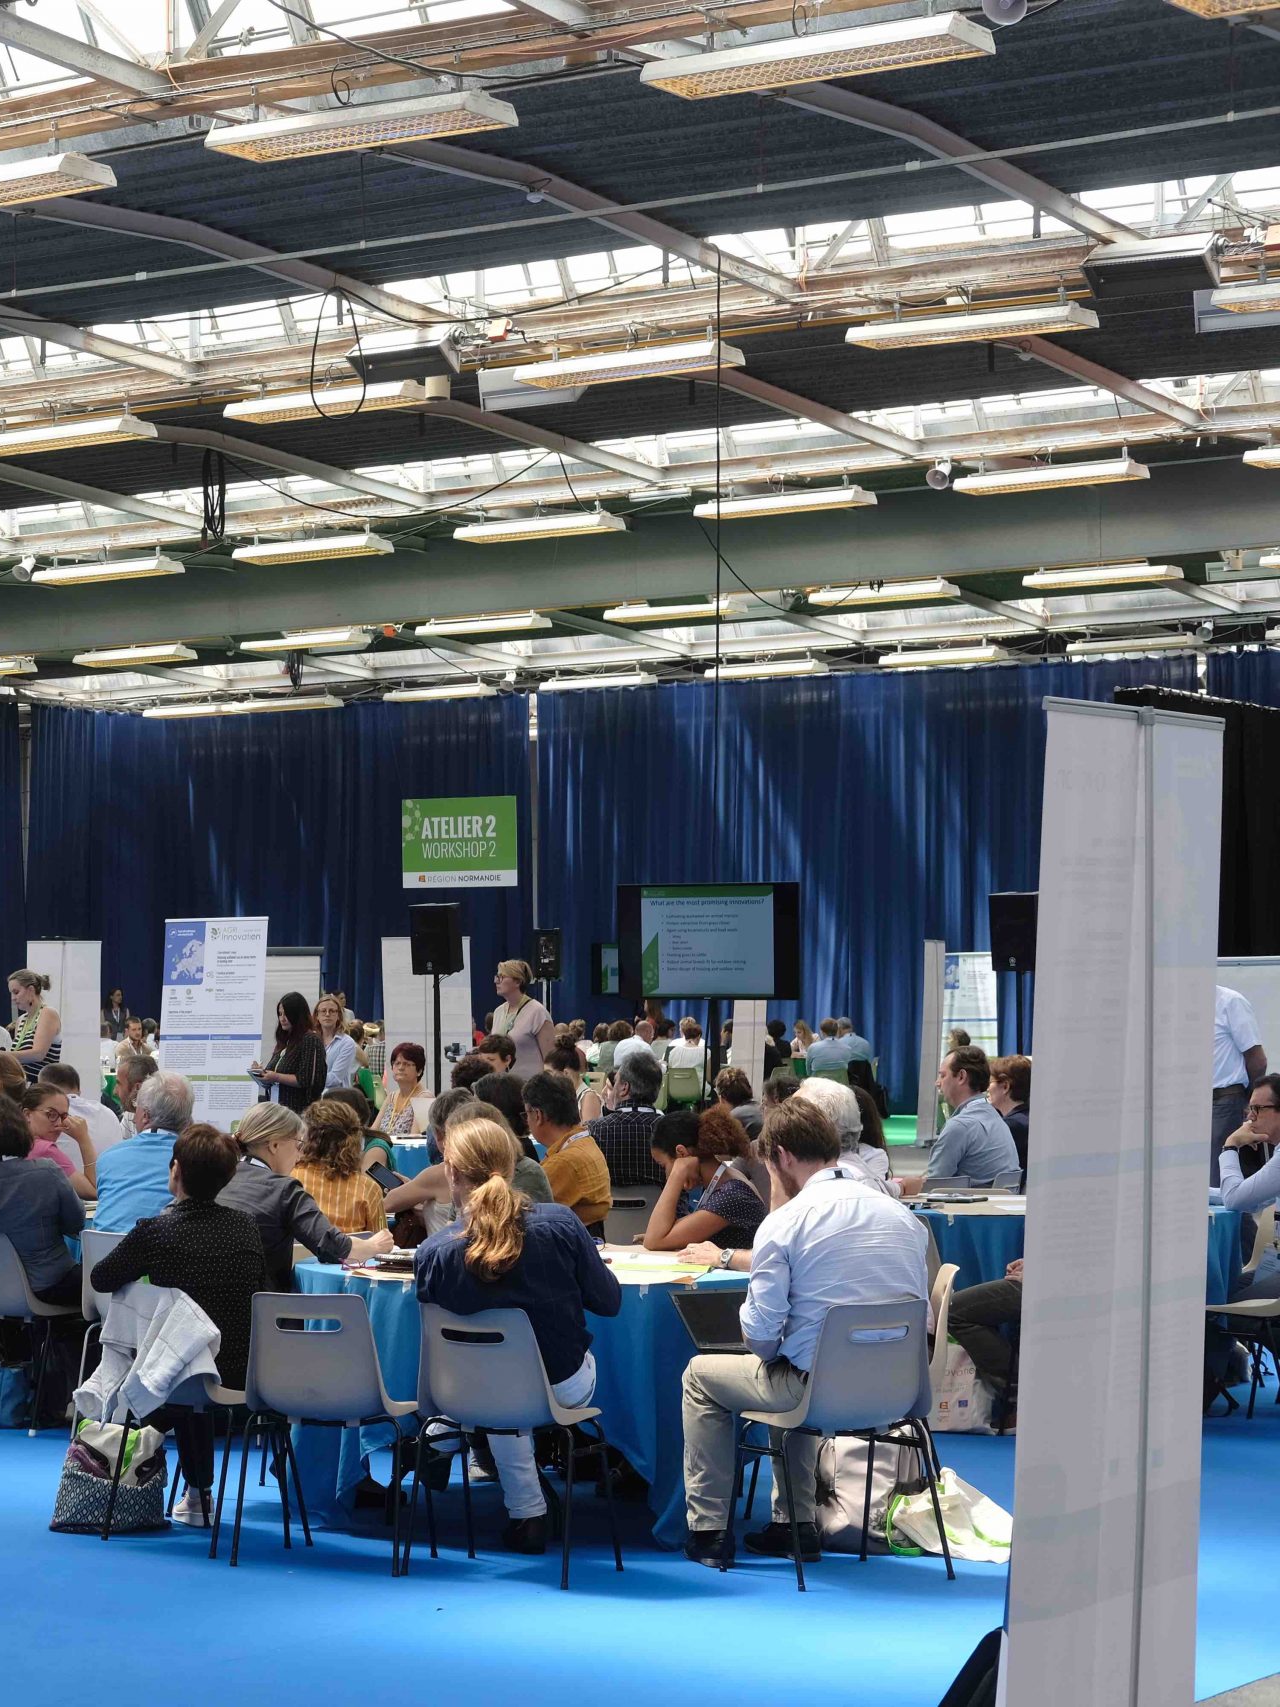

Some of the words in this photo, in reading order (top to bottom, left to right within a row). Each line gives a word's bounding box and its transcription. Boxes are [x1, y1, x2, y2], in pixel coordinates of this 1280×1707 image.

[422, 816, 483, 839] ATELIER
[486, 815, 497, 838] 2
[422, 841, 486, 859] WORKSHOP
[489, 841, 497, 857] 2
[458, 875, 502, 883] NORMANDIE
[650, 899, 665, 907] What
